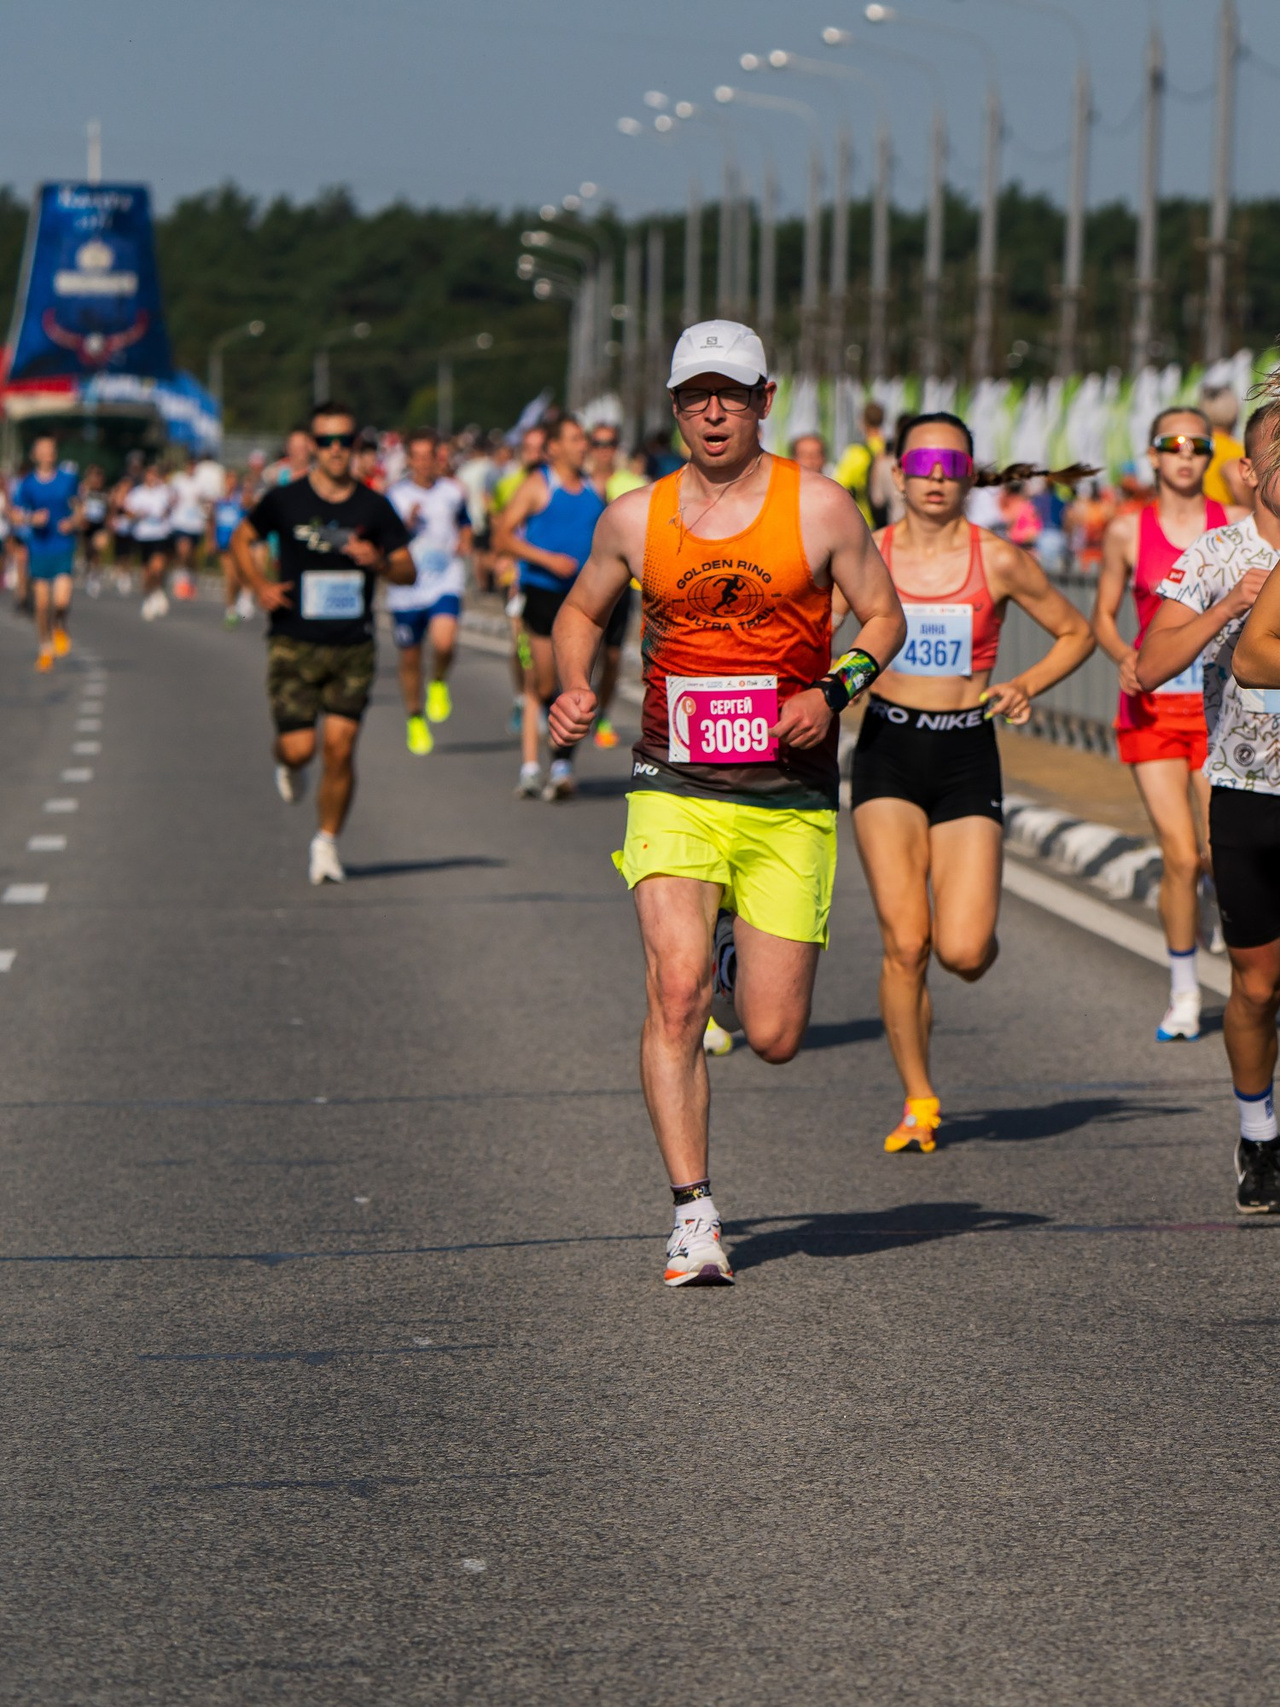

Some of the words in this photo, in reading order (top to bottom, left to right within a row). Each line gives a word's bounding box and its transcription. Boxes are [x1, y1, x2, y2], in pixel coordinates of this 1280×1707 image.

[677, 560, 733, 590] GOLDEN
[737, 560, 772, 584] RING
[684, 611, 733, 631] ULTRA
[738, 606, 776, 631] TRAIL
[904, 639, 962, 667] 4367
[710, 696, 753, 715] СЕРГЕЙ
[916, 709, 983, 731] NIKE
[700, 717, 769, 754] 3089
